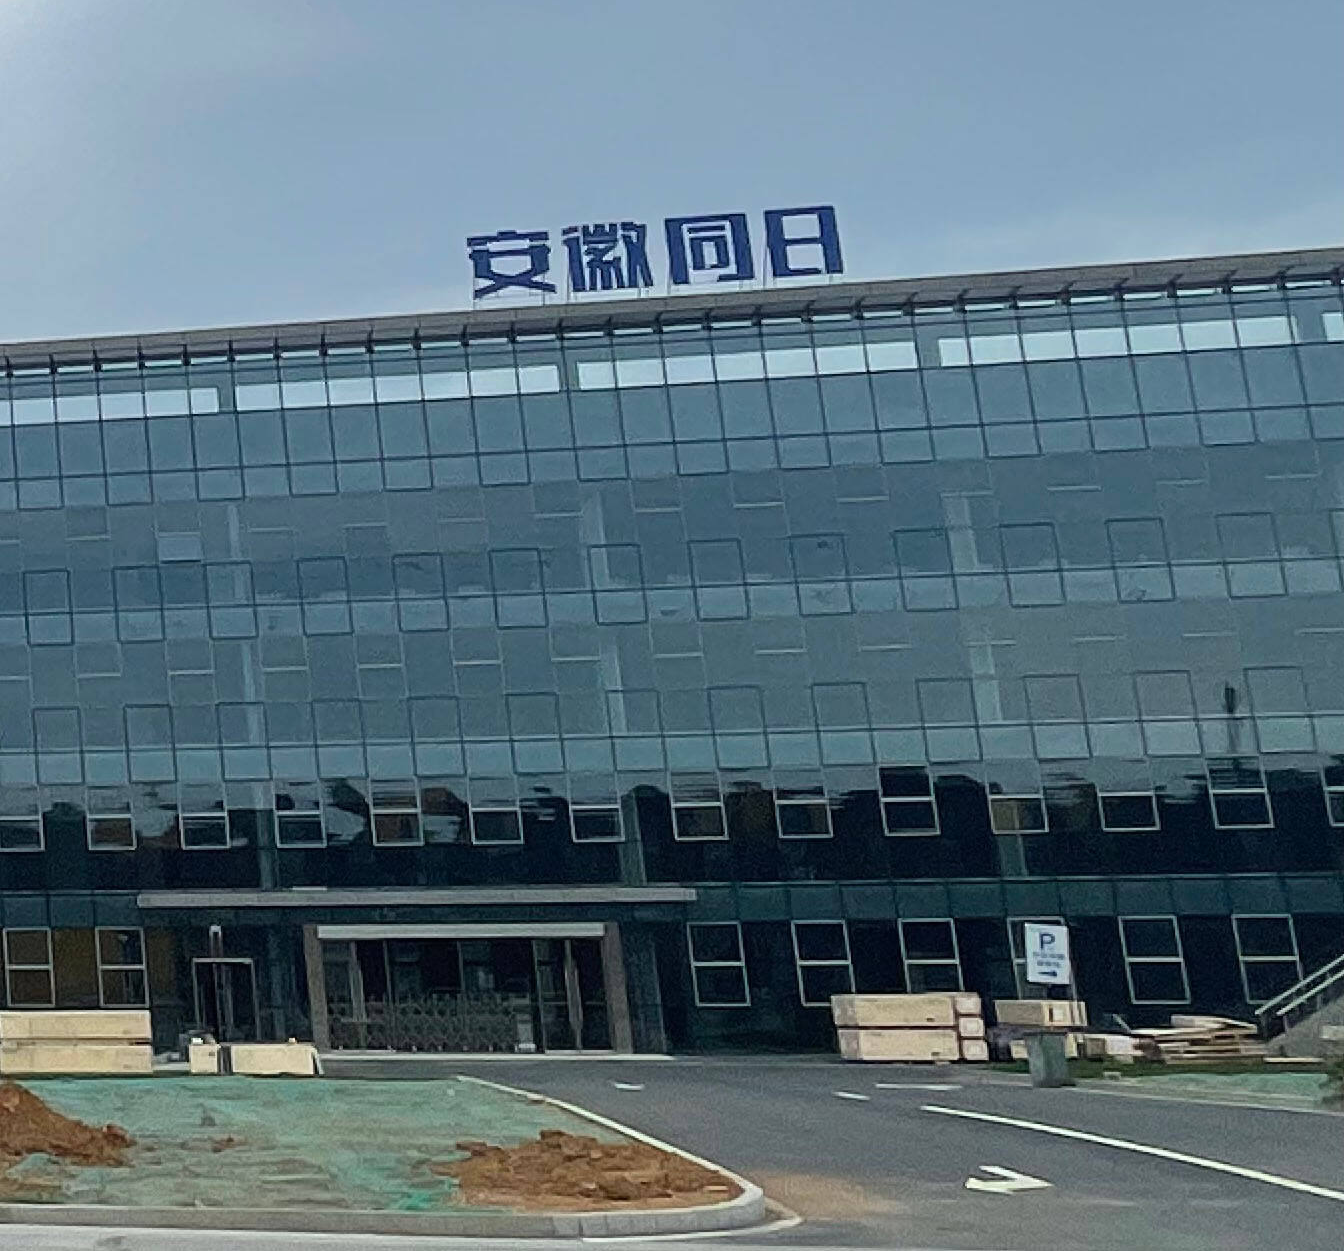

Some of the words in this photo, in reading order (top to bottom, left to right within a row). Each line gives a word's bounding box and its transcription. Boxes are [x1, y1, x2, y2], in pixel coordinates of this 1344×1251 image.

[466, 205, 844, 299] 安徽同日
[1039, 933, 1056, 949] P
